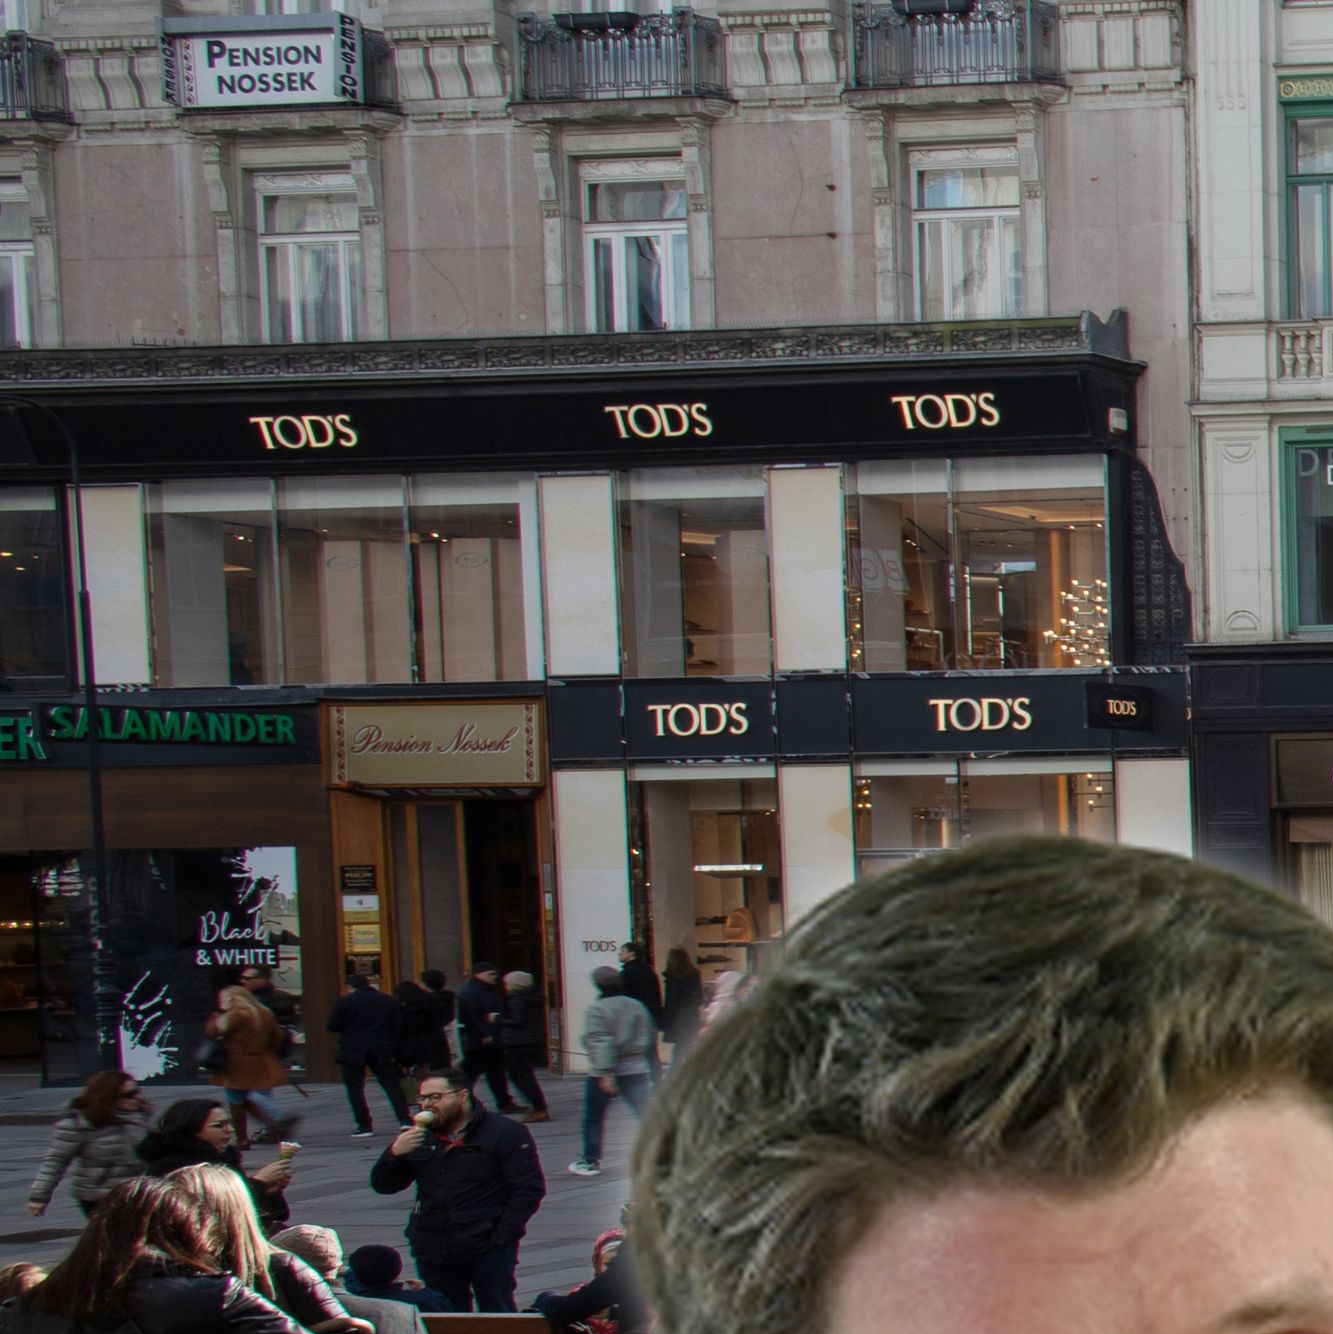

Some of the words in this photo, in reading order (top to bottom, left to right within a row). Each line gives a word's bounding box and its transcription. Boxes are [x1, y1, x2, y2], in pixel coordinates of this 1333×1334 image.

[160, 36, 177, 102] NOSSEK
[206, 40, 323, 68] PENSION
[340, 15, 358, 100] PENSION
[217, 72, 318, 94] NOSSEK
[605, 403, 714, 438] TOD'S
[891, 393, 1001, 429] TOD'S
[248, 414, 359, 449] TOD'S
[50, 705, 298, 745] SALAMANDER
[647, 702, 749, 737] TOD'S
[929, 698, 1032, 732] TOD'S
[351, 724, 433, 753] Pension
[437, 722, 519, 754] Nossek
[199, 910, 267, 943] Black
[195, 949, 212, 965] &
[214, 948, 277, 965] WHITE
